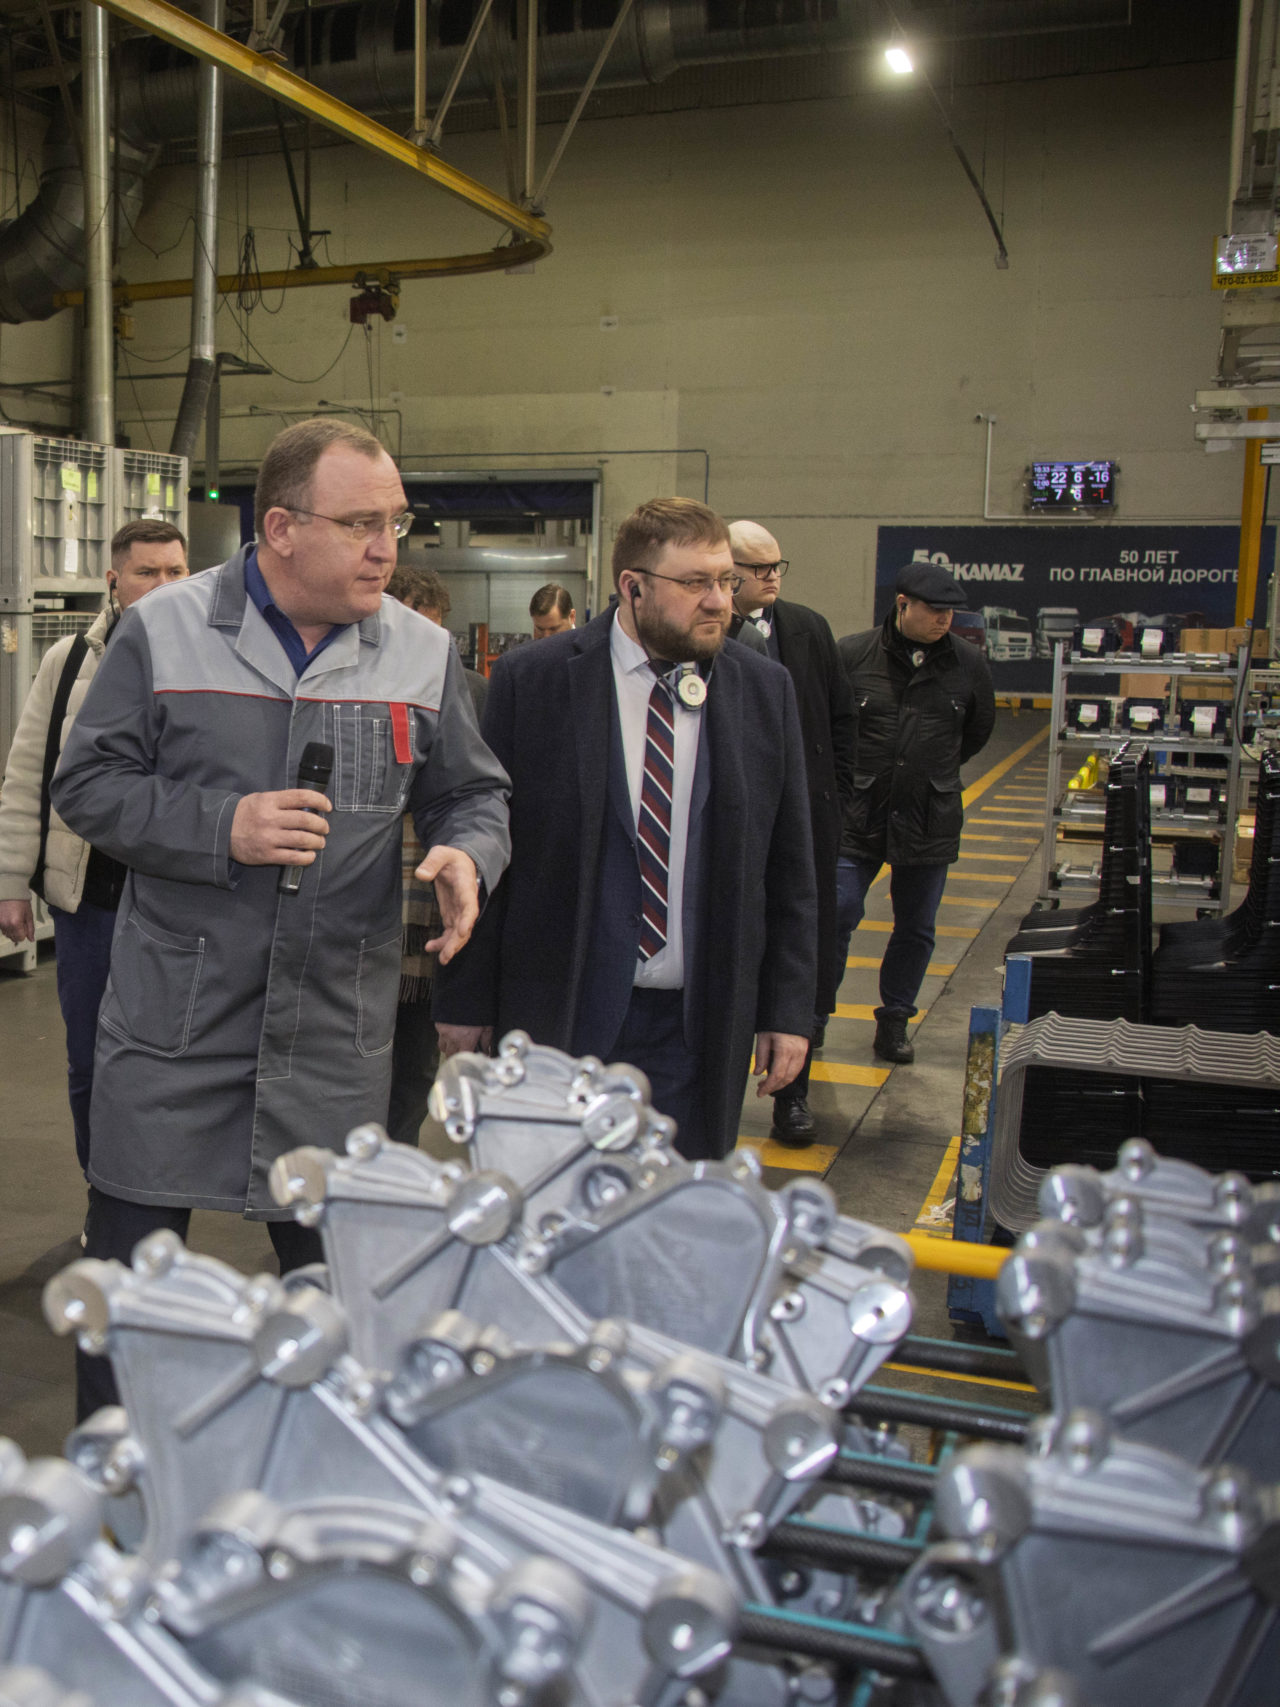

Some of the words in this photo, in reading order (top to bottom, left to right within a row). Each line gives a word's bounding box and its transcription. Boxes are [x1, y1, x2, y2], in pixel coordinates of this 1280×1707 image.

[1051, 472, 1067, 484] 22
[1073, 472, 1083, 483] 6
[1054, 488, 1063, 500] 7
[1120, 550, 1139, 564] 50
[1143, 550, 1179, 564] ЛЕТ
[953, 563, 1025, 581] KAMAZ
[1049, 567, 1075, 582] ПО
[1080, 565, 1165, 582] ГЛАВНОЙ
